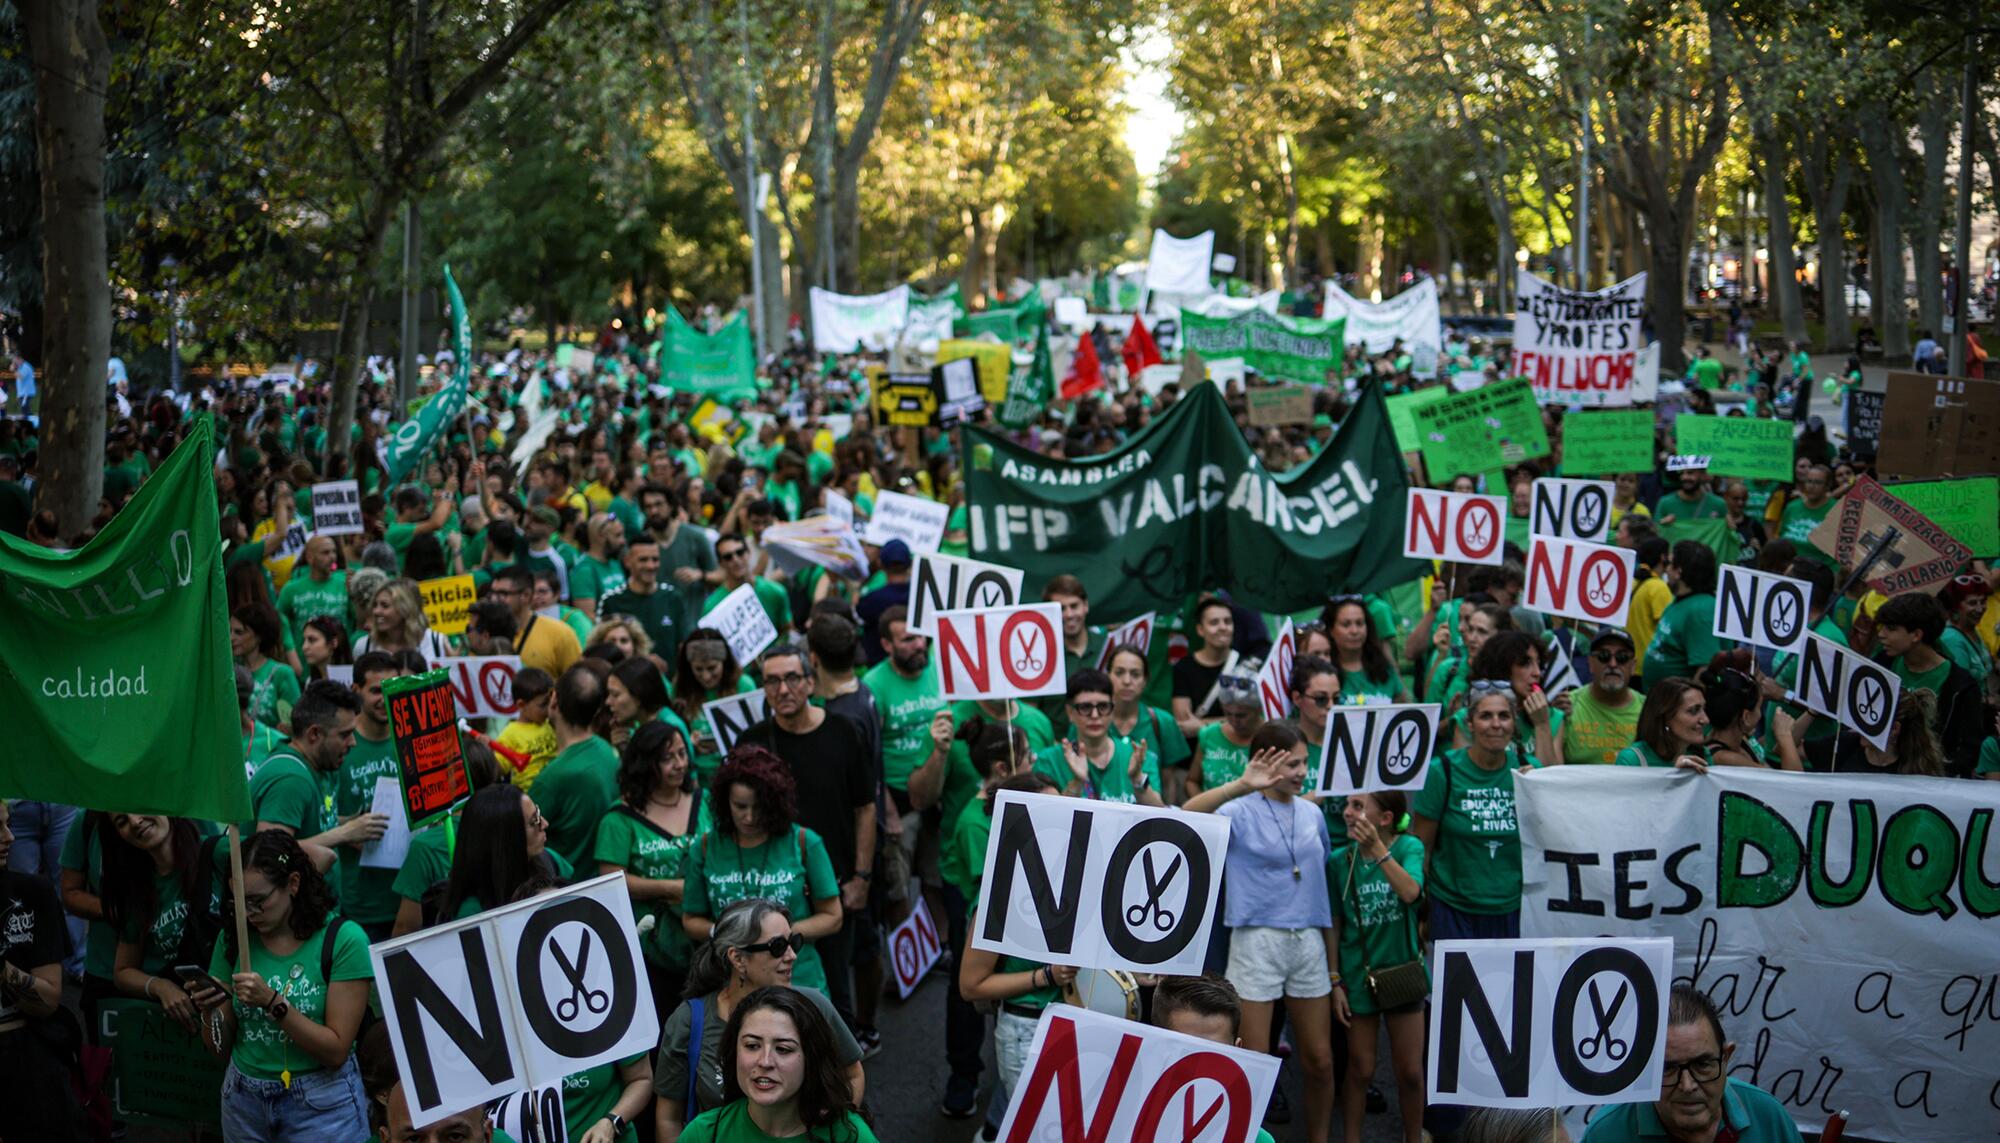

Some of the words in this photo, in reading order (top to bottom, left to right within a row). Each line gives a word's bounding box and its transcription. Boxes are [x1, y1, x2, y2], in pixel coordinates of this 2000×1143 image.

[970, 504, 1069, 552] IFP
[1099, 454, 1378, 538] VALCÁRCEL
[1001, 449, 1152, 486] ASAMBLEA
[1409, 493, 1500, 559] NO
[1534, 483, 1608, 538] NO
[422, 584, 472, 606] sticia
[913, 558, 1013, 629] NO
[1528, 541, 1627, 618] NO
[1718, 570, 1804, 646] NO
[1883, 559, 1956, 592] SALARIO
[42, 665, 149, 698] calidad
[938, 610, 1058, 694] NO
[1799, 636, 1893, 737] NO
[392, 698, 413, 738] SE
[710, 697, 773, 757] N
[1322, 709, 1431, 787] NO
[1483, 819, 1517, 831] RIVAS
[1544, 843, 1704, 920] IES
[1716, 790, 2000, 920] DUQU
[983, 802, 1211, 965] NO
[382, 895, 638, 1112] NO
[1436, 946, 1659, 1098] NO
[1854, 971, 1905, 1020] a
[1006, 1015, 1252, 1143] NO
[1893, 1069, 1938, 1118] a
